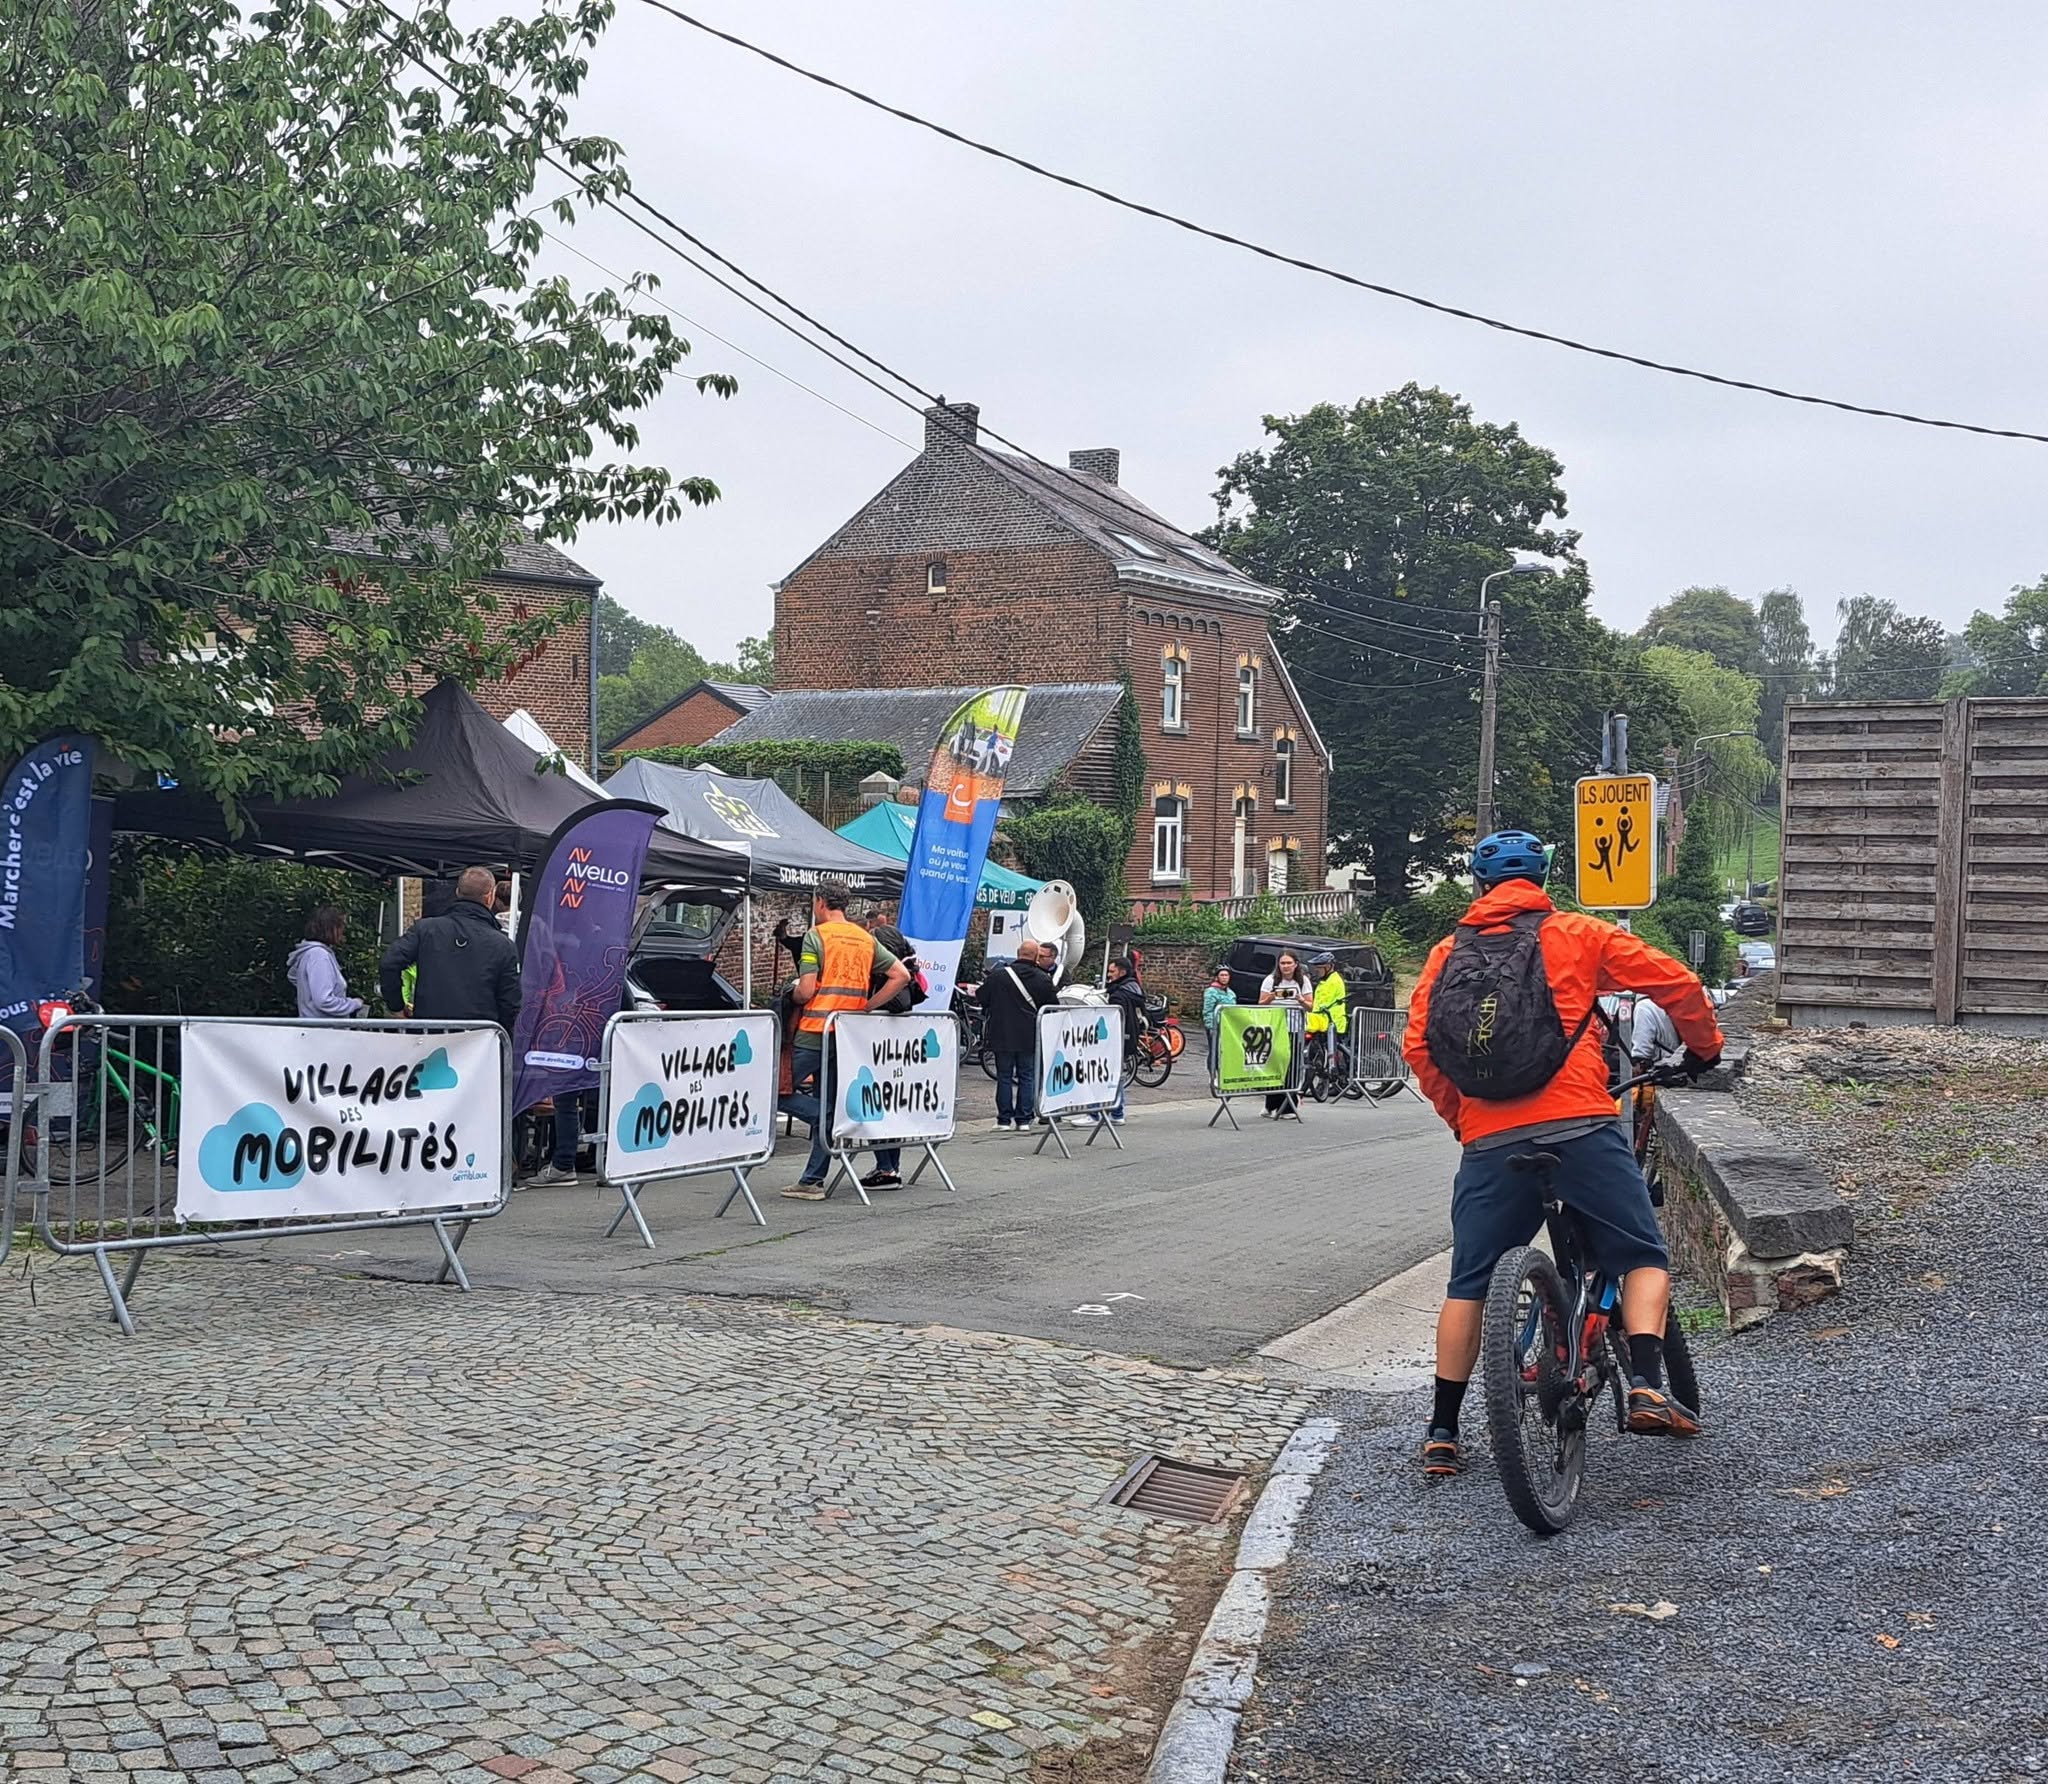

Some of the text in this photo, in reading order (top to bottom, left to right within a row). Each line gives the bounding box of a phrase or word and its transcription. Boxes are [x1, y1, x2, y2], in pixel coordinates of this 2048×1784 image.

[1579, 783, 1649, 804] ILS JOUENT
[0, 827, 22, 930] Marcher
[29, 761, 54, 782] la
[53, 750, 83, 768] vie
[931, 845, 946, 856] Ma
[919, 867, 946, 880] quand
[950, 862, 967, 872] veu
[0, 1001, 28, 1019] ous
[873, 1038, 928, 1067] VILLAGE
[661, 1042, 737, 1082] VILLAGE
[893, 1067, 904, 1078] DES
[283, 1063, 425, 1105] VILLAGE
[689, 1080, 703, 1094] DES
[340, 1108, 363, 1124] DES
